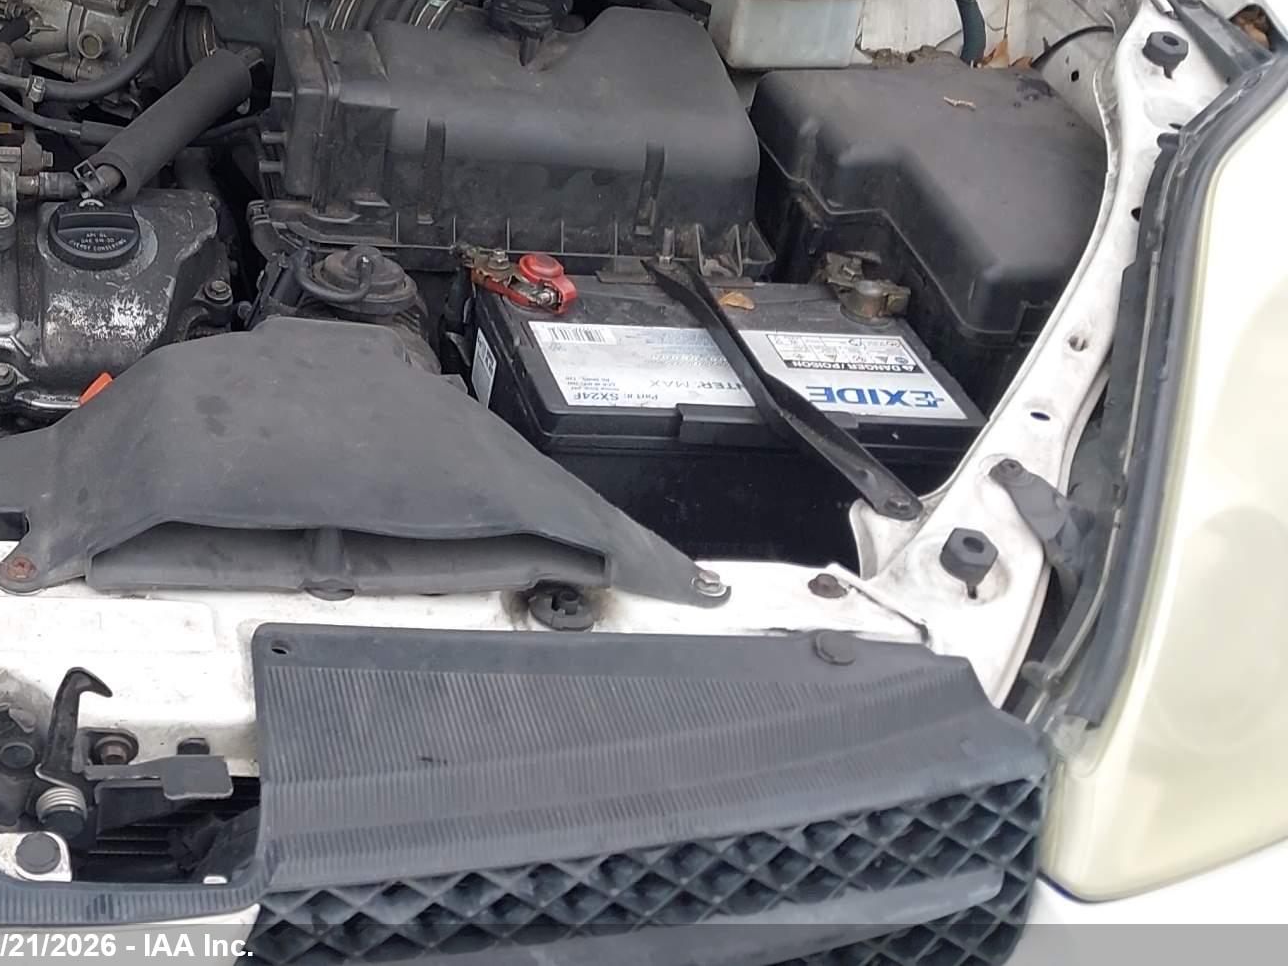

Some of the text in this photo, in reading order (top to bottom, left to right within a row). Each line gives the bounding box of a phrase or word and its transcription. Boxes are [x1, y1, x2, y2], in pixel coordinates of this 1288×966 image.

[650, 379, 689, 388] MAX
[572, 392, 619, 401] SX24F
[806, 385, 944, 408] EXIDE
